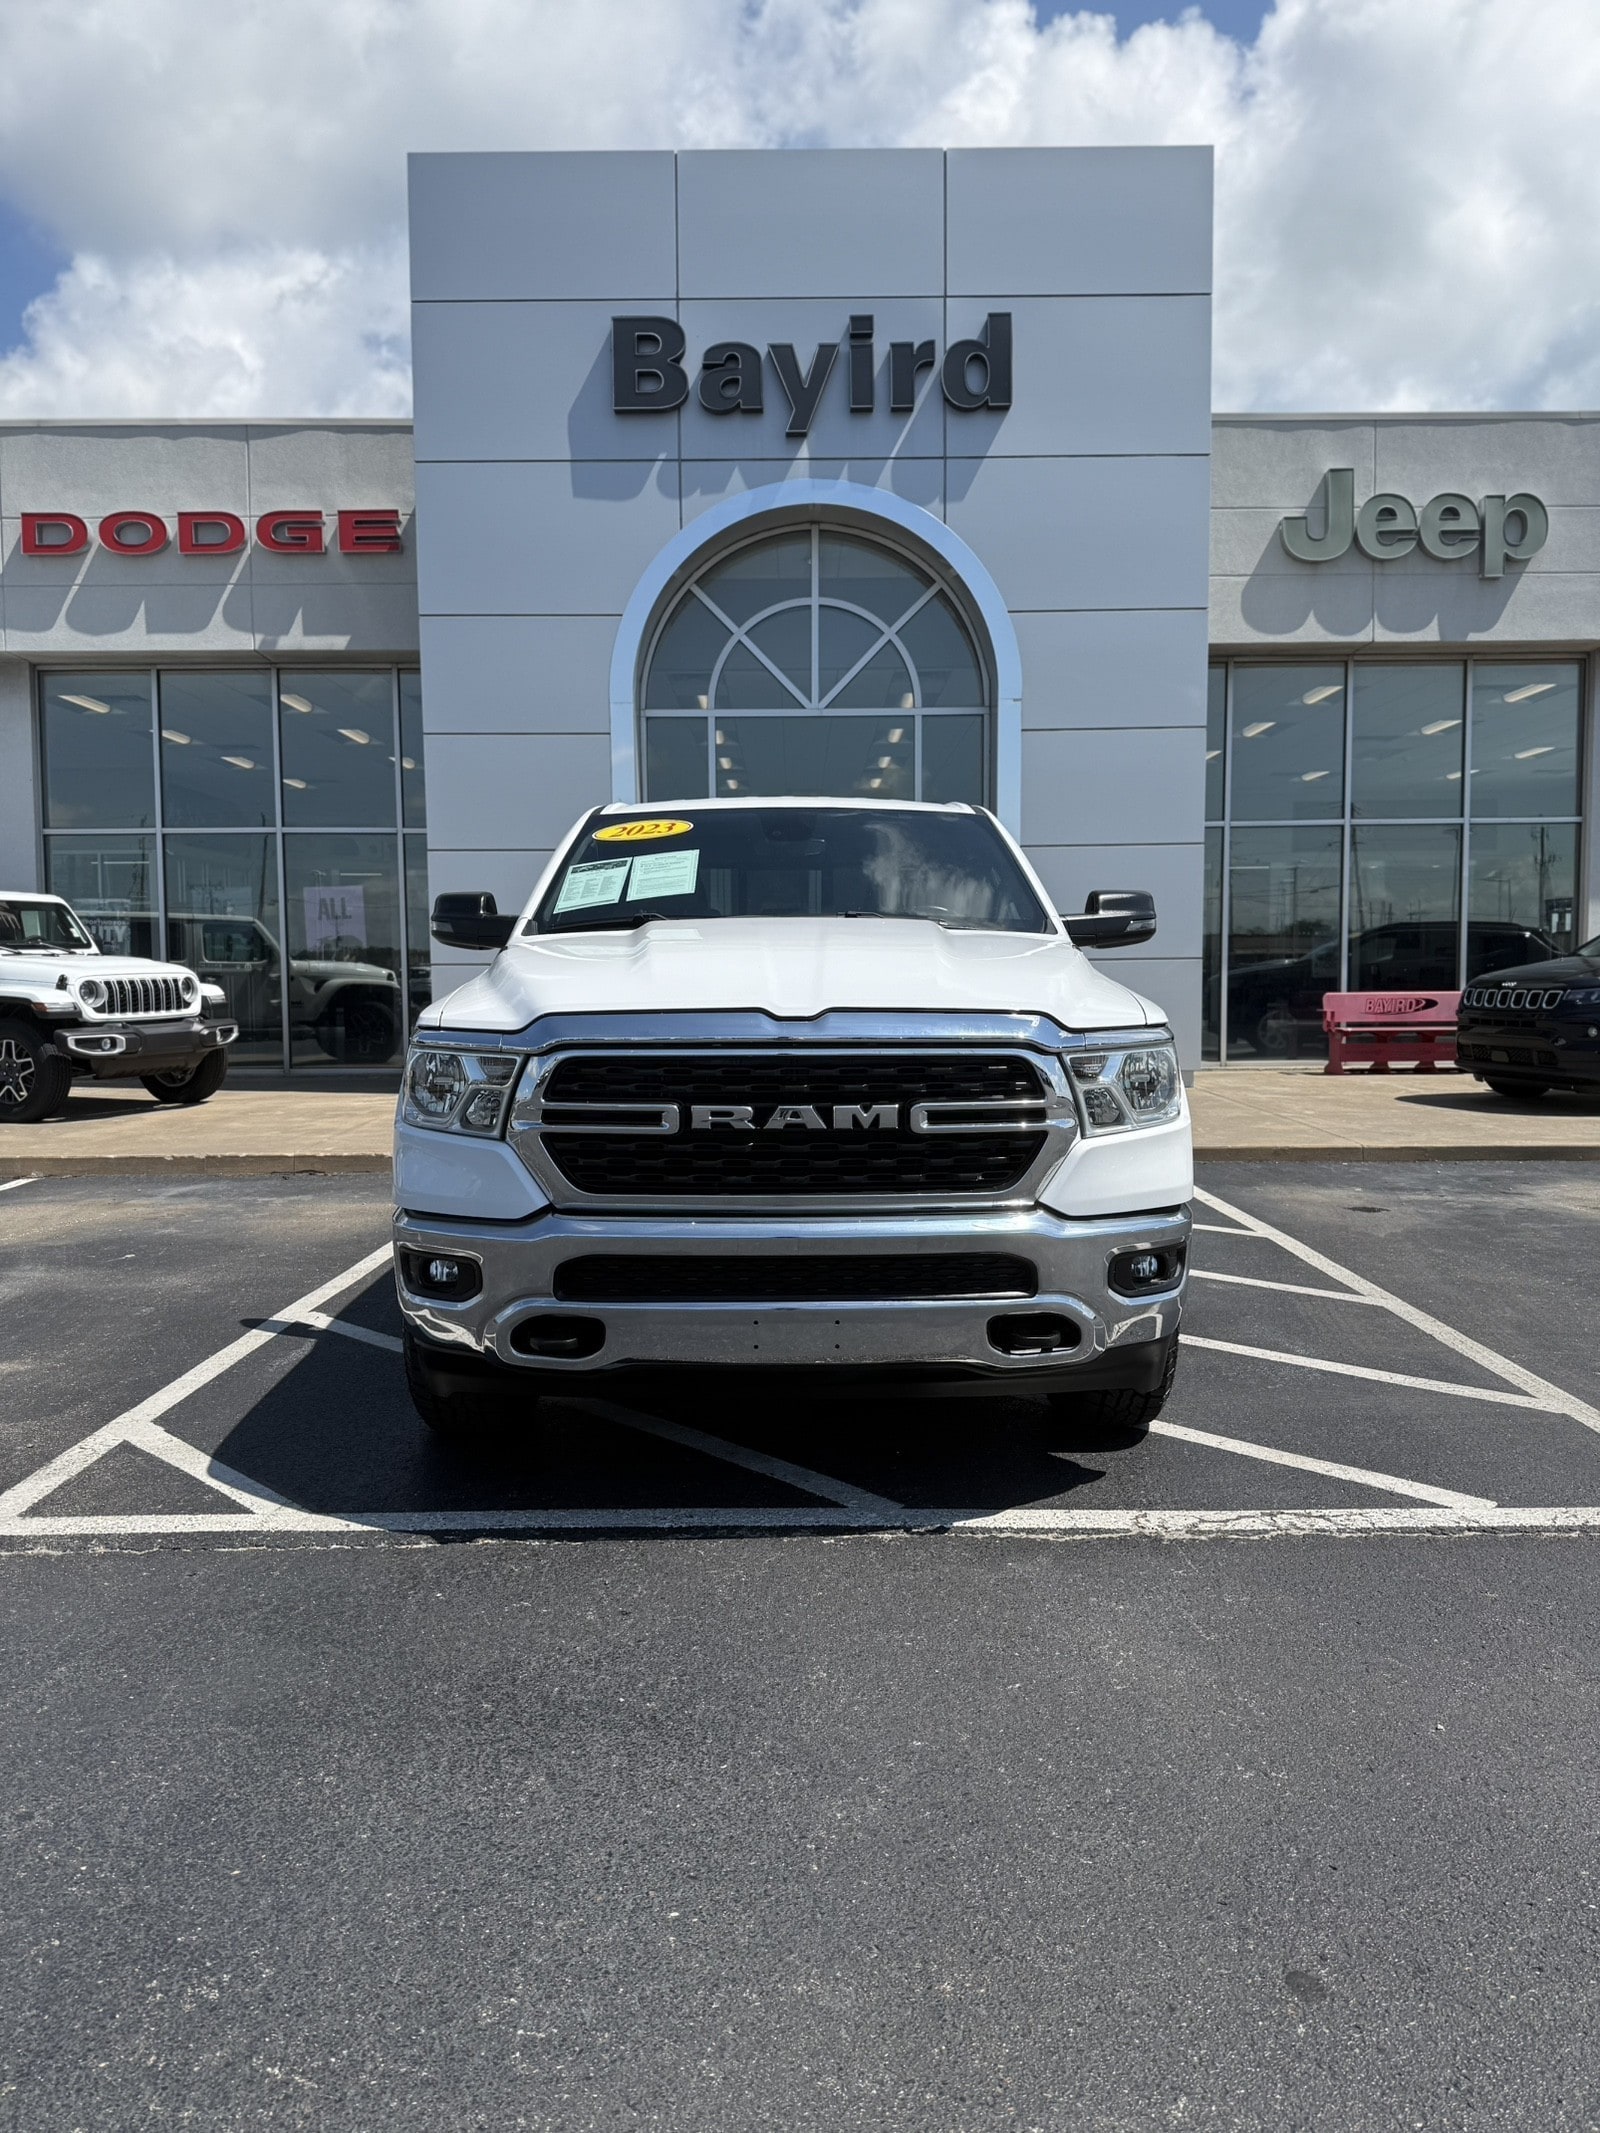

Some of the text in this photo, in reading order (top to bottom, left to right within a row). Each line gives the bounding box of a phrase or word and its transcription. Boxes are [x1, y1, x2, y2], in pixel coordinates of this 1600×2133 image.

[611, 312, 1012, 437] Bayird
[20, 510, 402, 555] DODGE
[1280, 468, 1549, 578] Jeep
[609, 823, 677, 837] 2023
[318, 897, 352, 920] ALL
[1364, 998, 1417, 1014] BAYIRD
[691, 1104, 899, 1129] RAM
